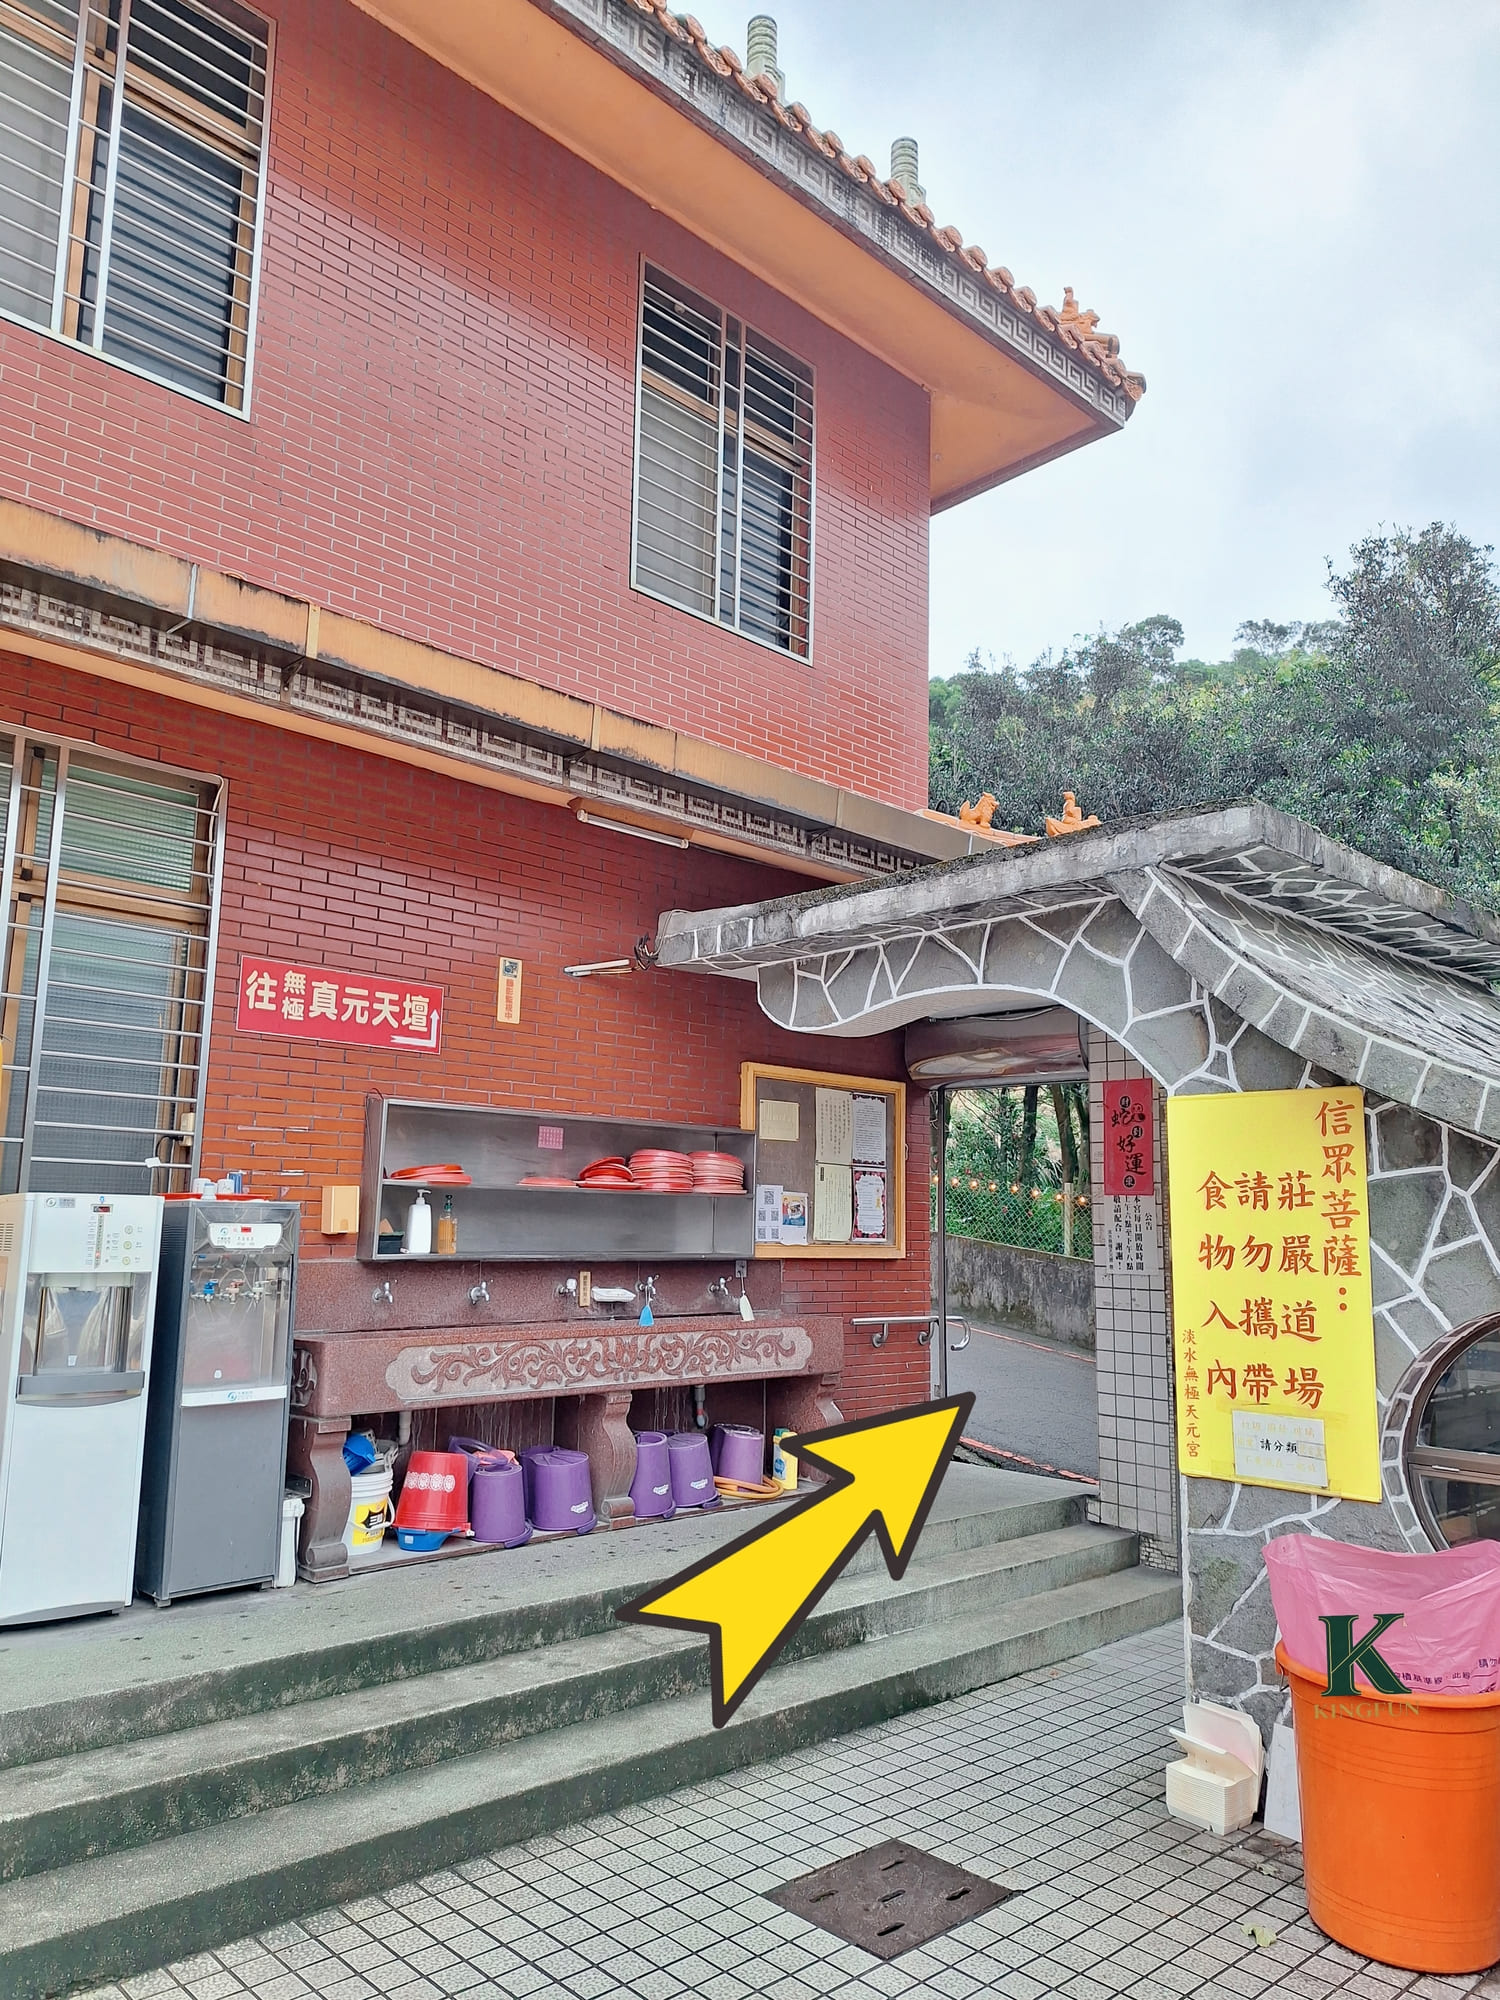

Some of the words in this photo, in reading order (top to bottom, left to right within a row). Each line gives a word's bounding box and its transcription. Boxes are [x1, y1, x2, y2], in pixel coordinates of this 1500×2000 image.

[246, 970, 430, 1032] 往無極真元天壇
[1145, 1212, 1152, 1231] 公告
[1196, 1170, 1239, 1400] 食物入內
[1234, 1171, 1278, 1403] 請勿攜帶
[1277, 1170, 1325, 1409] 莊嚴道場
[1182, 1329, 1200, 1457] 淡水無極天元宮
[1260, 1438, 1297, 1453] 請分類
